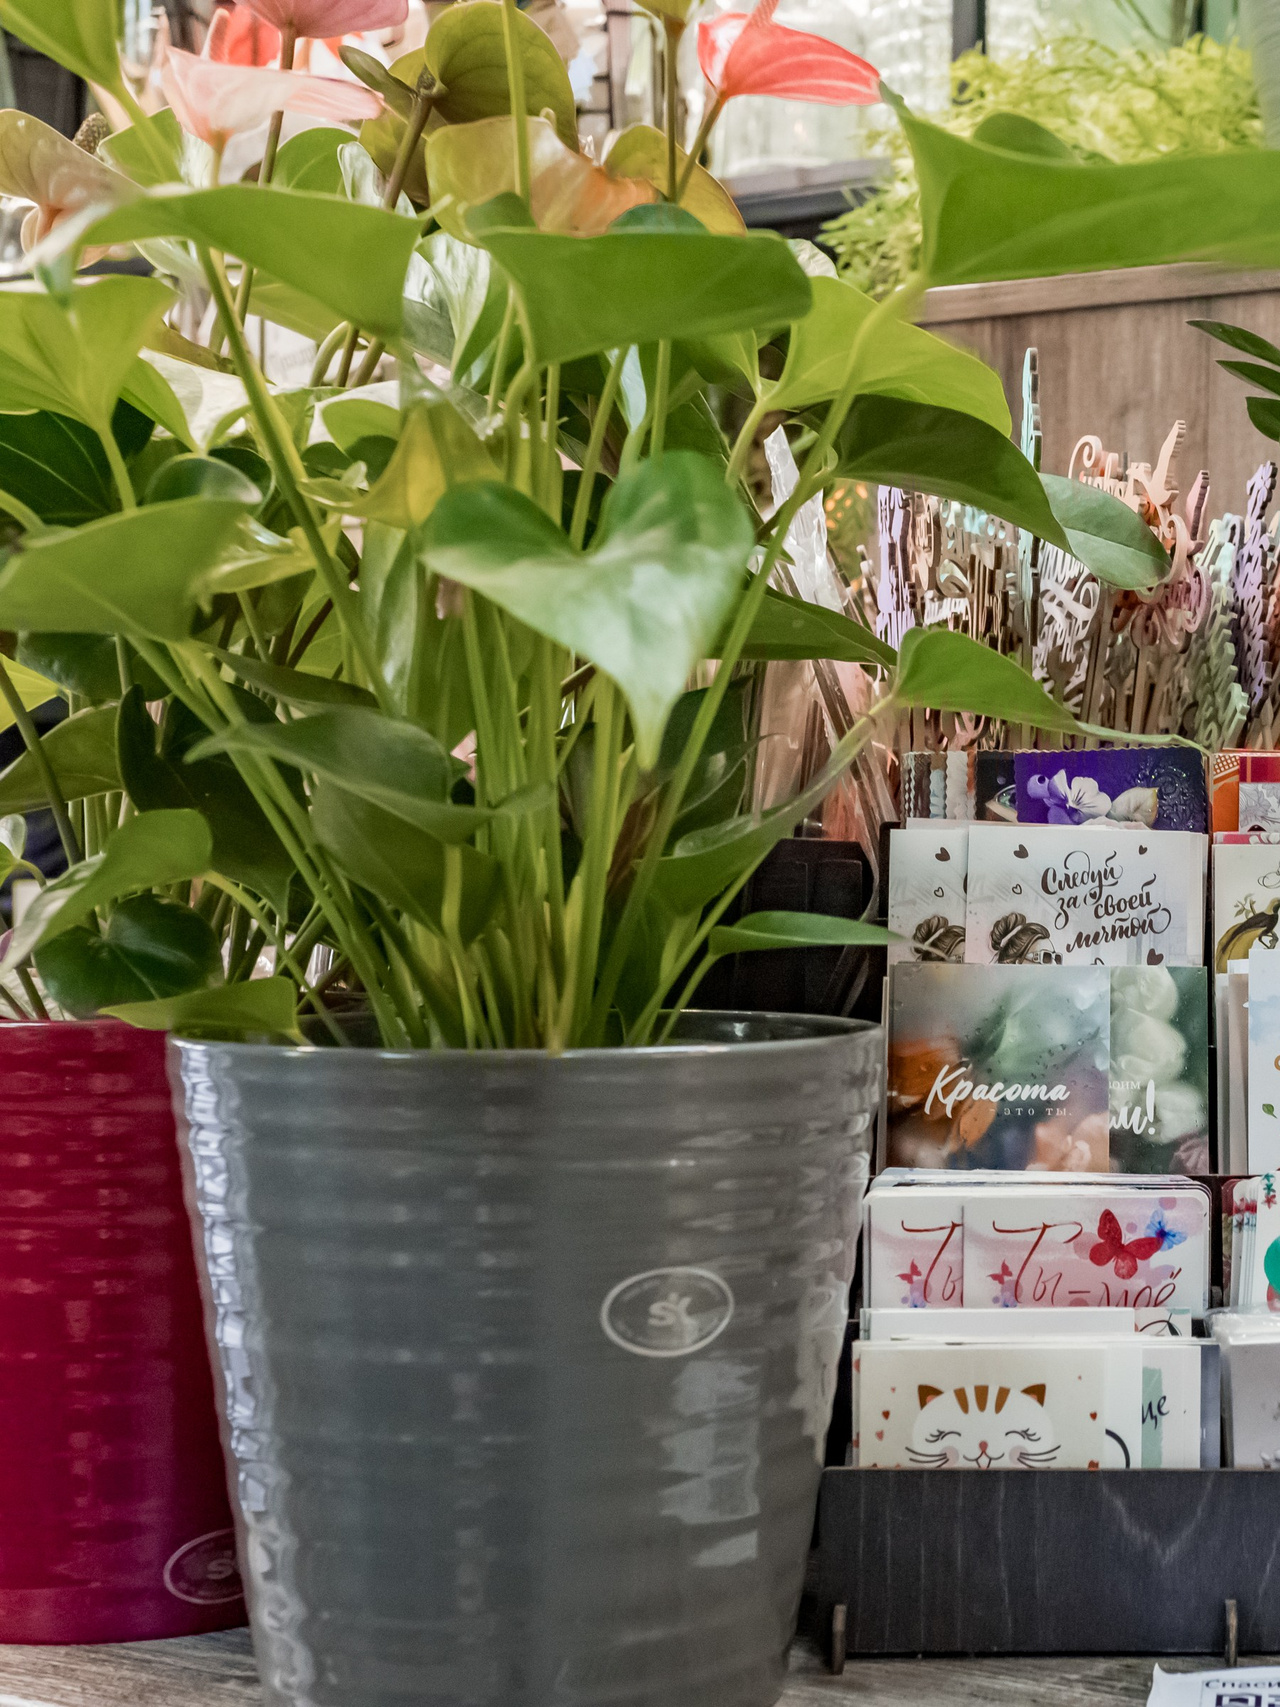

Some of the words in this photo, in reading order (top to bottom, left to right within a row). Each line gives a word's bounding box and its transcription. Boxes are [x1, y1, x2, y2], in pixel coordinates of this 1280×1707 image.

[1041, 850, 1123, 906] Следуй
[1054, 895, 1080, 930] за
[1094, 873, 1157, 919] своей
[1066, 903, 1172, 953] мечтой
[924, 1064, 1070, 1119] Красота
